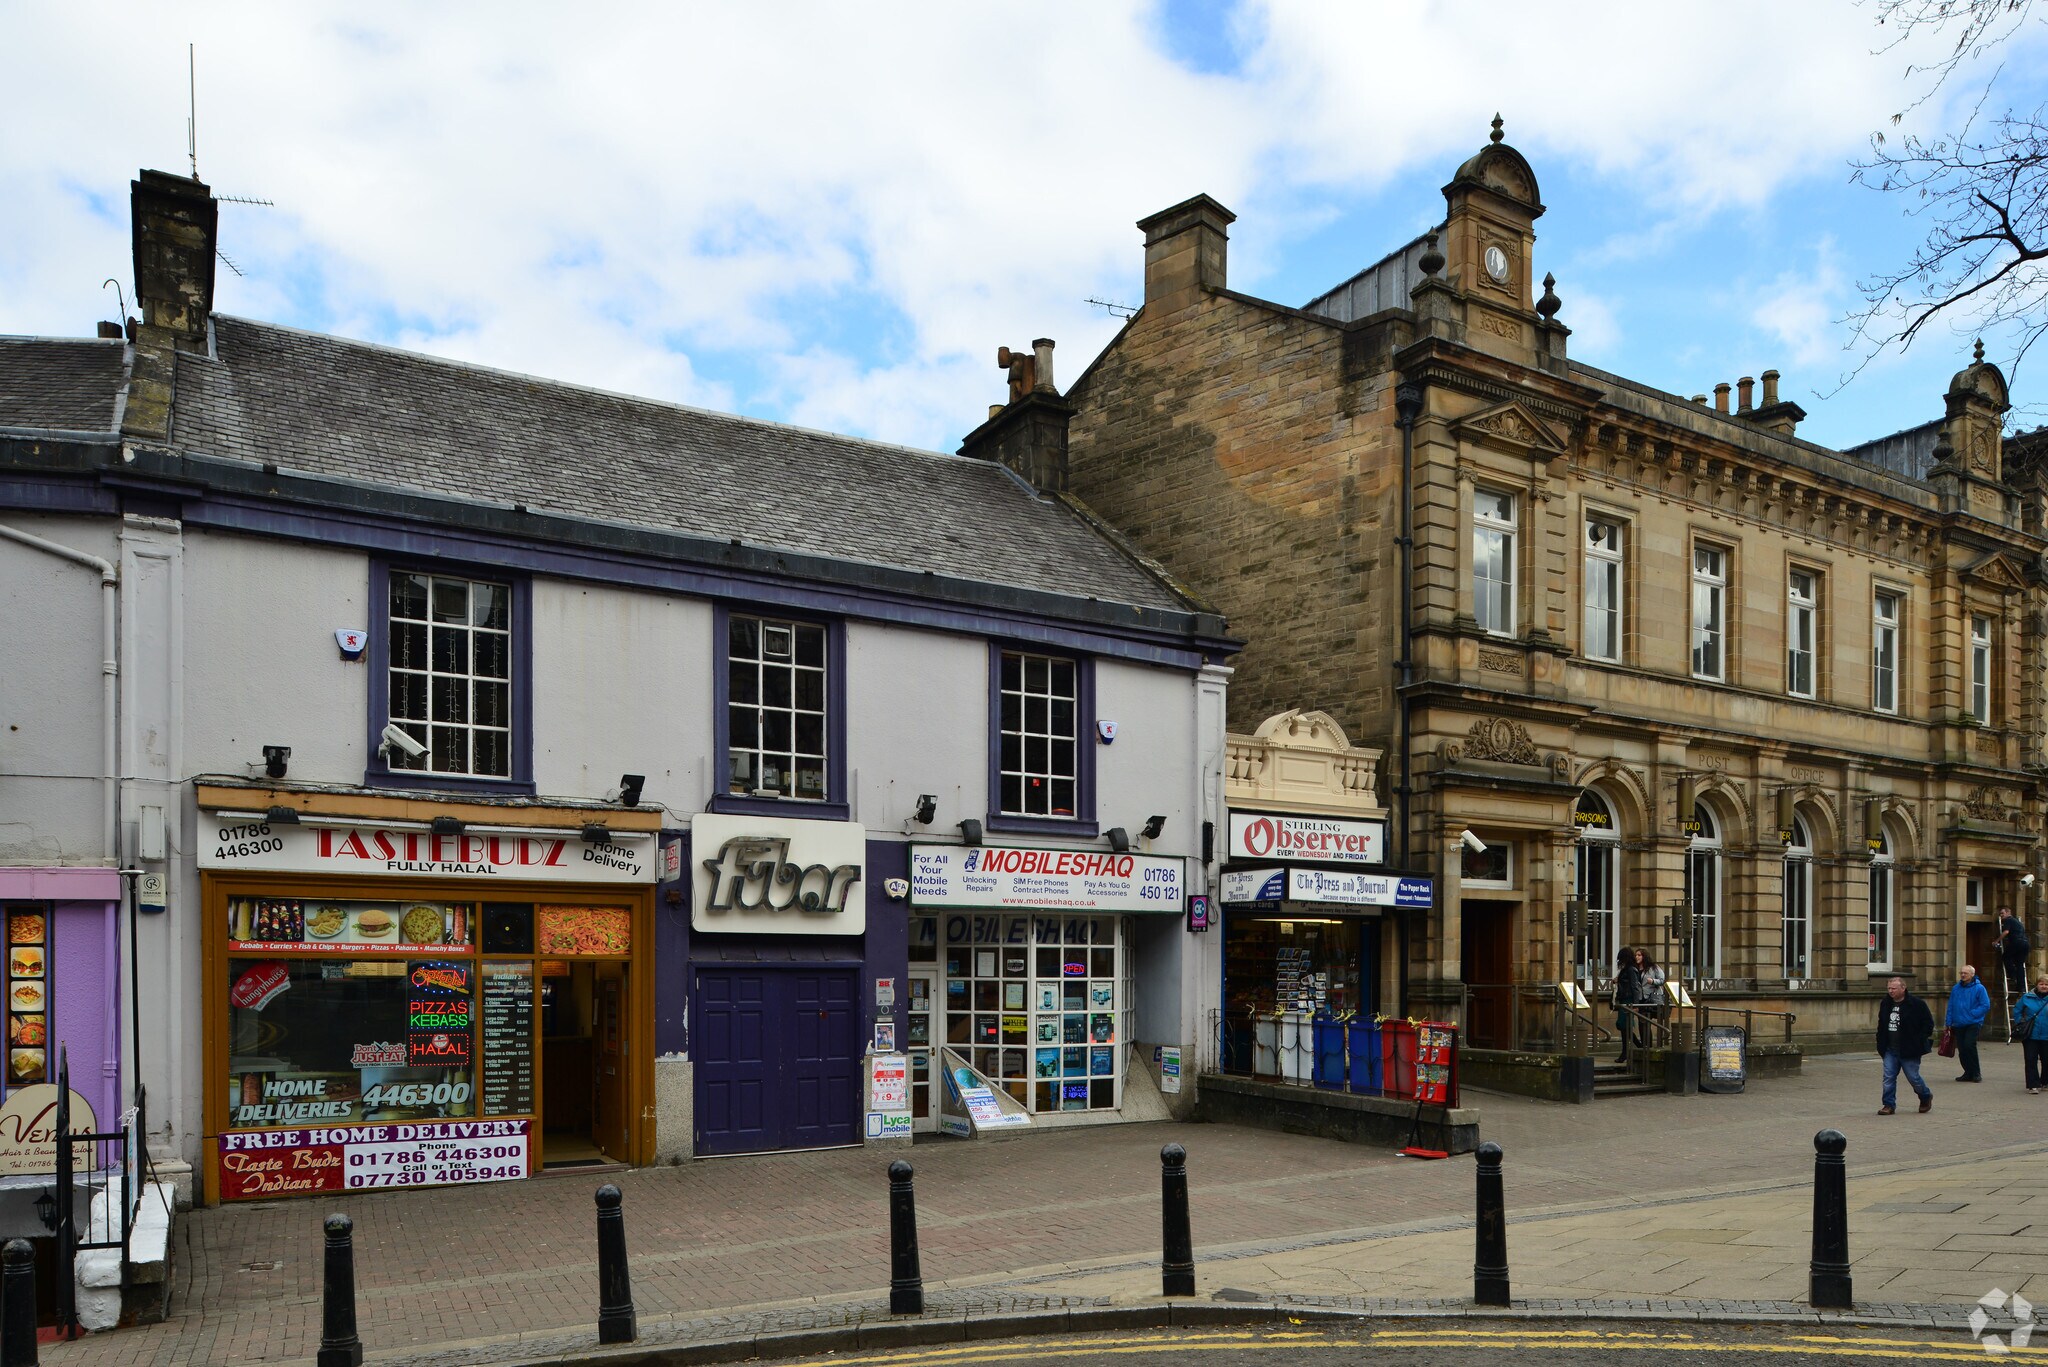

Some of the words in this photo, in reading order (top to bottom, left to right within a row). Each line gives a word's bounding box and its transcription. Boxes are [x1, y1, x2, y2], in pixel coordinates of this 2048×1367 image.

[1698, 754, 1730, 770] POST
[1791, 766, 1824, 782] OFFICE
[219, 823, 271, 841] 01786
[1285, 821, 1341, 832] STIRLING
[1243, 817, 1371, 856] Observer
[215, 837, 283, 860] 446300
[309, 828, 567, 867] TASTEBUDZ
[594, 840, 635, 859] Home
[913, 855, 931, 864] For
[935, 855, 948, 864] All
[1277, 849, 1294, 857] EVERY
[1297, 851, 1332, 859] WEDNESDAY
[1345, 853, 1368, 861] FRIDAY
[387, 861, 434, 872] FULLY
[441, 862, 497, 874] HALAL
[582, 849, 642, 876] Delivery
[981, 850, 1134, 878] MOBILESHAQ
[703, 836, 861, 912] fubar
[920, 865, 943, 874] Your
[1144, 868, 1175, 882] 01786
[913, 876, 948, 886] Mobile
[962, 876, 997, 886] Unlocking
[1044, 879, 1069, 887] Phones
[1227, 875, 1237, 883] The
[1238, 872, 1254, 884] Press
[1297, 873, 1313, 889] The
[1314, 872, 1340, 894] Press
[1342, 879, 1355, 892] and
[1356, 876, 1388, 895] Journal
[913, 886, 947, 896] Needs
[966, 884, 993, 893] Repairs
[1012, 886, 1043, 894] Contract
[1044, 887, 1069, 895] Phones
[1084, 881, 1096, 889] Pay
[1235, 884, 1244, 892] and
[1408, 885, 1419, 893] Paper
[1087, 889, 1128, 897] Accessories
[1140, 886, 1161, 899] 450
[1164, 887, 1179, 900] 121
[1228, 890, 1250, 901] Journal
[1002, 897, 1096, 907] www.mobileshaq.co.uk
[920, 915, 1098, 943] MOBILESHAQ
[1064, 965, 1085, 973] OPEN
[412, 970, 466, 987] ON
[233, 969, 286, 1006] hungryhouse
[410, 1002, 468, 1014] PIZZAS
[410, 1014, 468, 1026] KEBABS
[355, 1044, 376, 1052] Don't
[413, 1043, 467, 1055] HALAL
[353, 1052, 382, 1063] JUST
[383, 1051, 405, 1061] EAT
[264, 1079, 327, 1097] HOME
[362, 1083, 470, 1106] 446300
[238, 1100, 352, 1121] DELIVERIES
[884, 1115, 910, 1126] Lyca
[942, 1120, 969, 1132] Lycamobile
[225, 1131, 301, 1150] FREE
[309, 1125, 388, 1145] HOME
[396, 1120, 527, 1141] DELIVERY
[0, 1148, 21, 1156] Hair
[418, 1142, 457, 1150] Phone
[224, 1152, 282, 1172] Taste
[291, 1149, 341, 1169] Budz
[349, 1151, 426, 1167] 01786
[434, 1145, 521, 1161] 446300
[28, 1160, 52, 1168] 01786
[402, 1163, 428, 1172] Call
[448, 1161, 473, 1169] Text
[242, 1169, 324, 1193] Indian's
[349, 1172, 426, 1188] 07730
[434, 1165, 521, 1181] 405946
